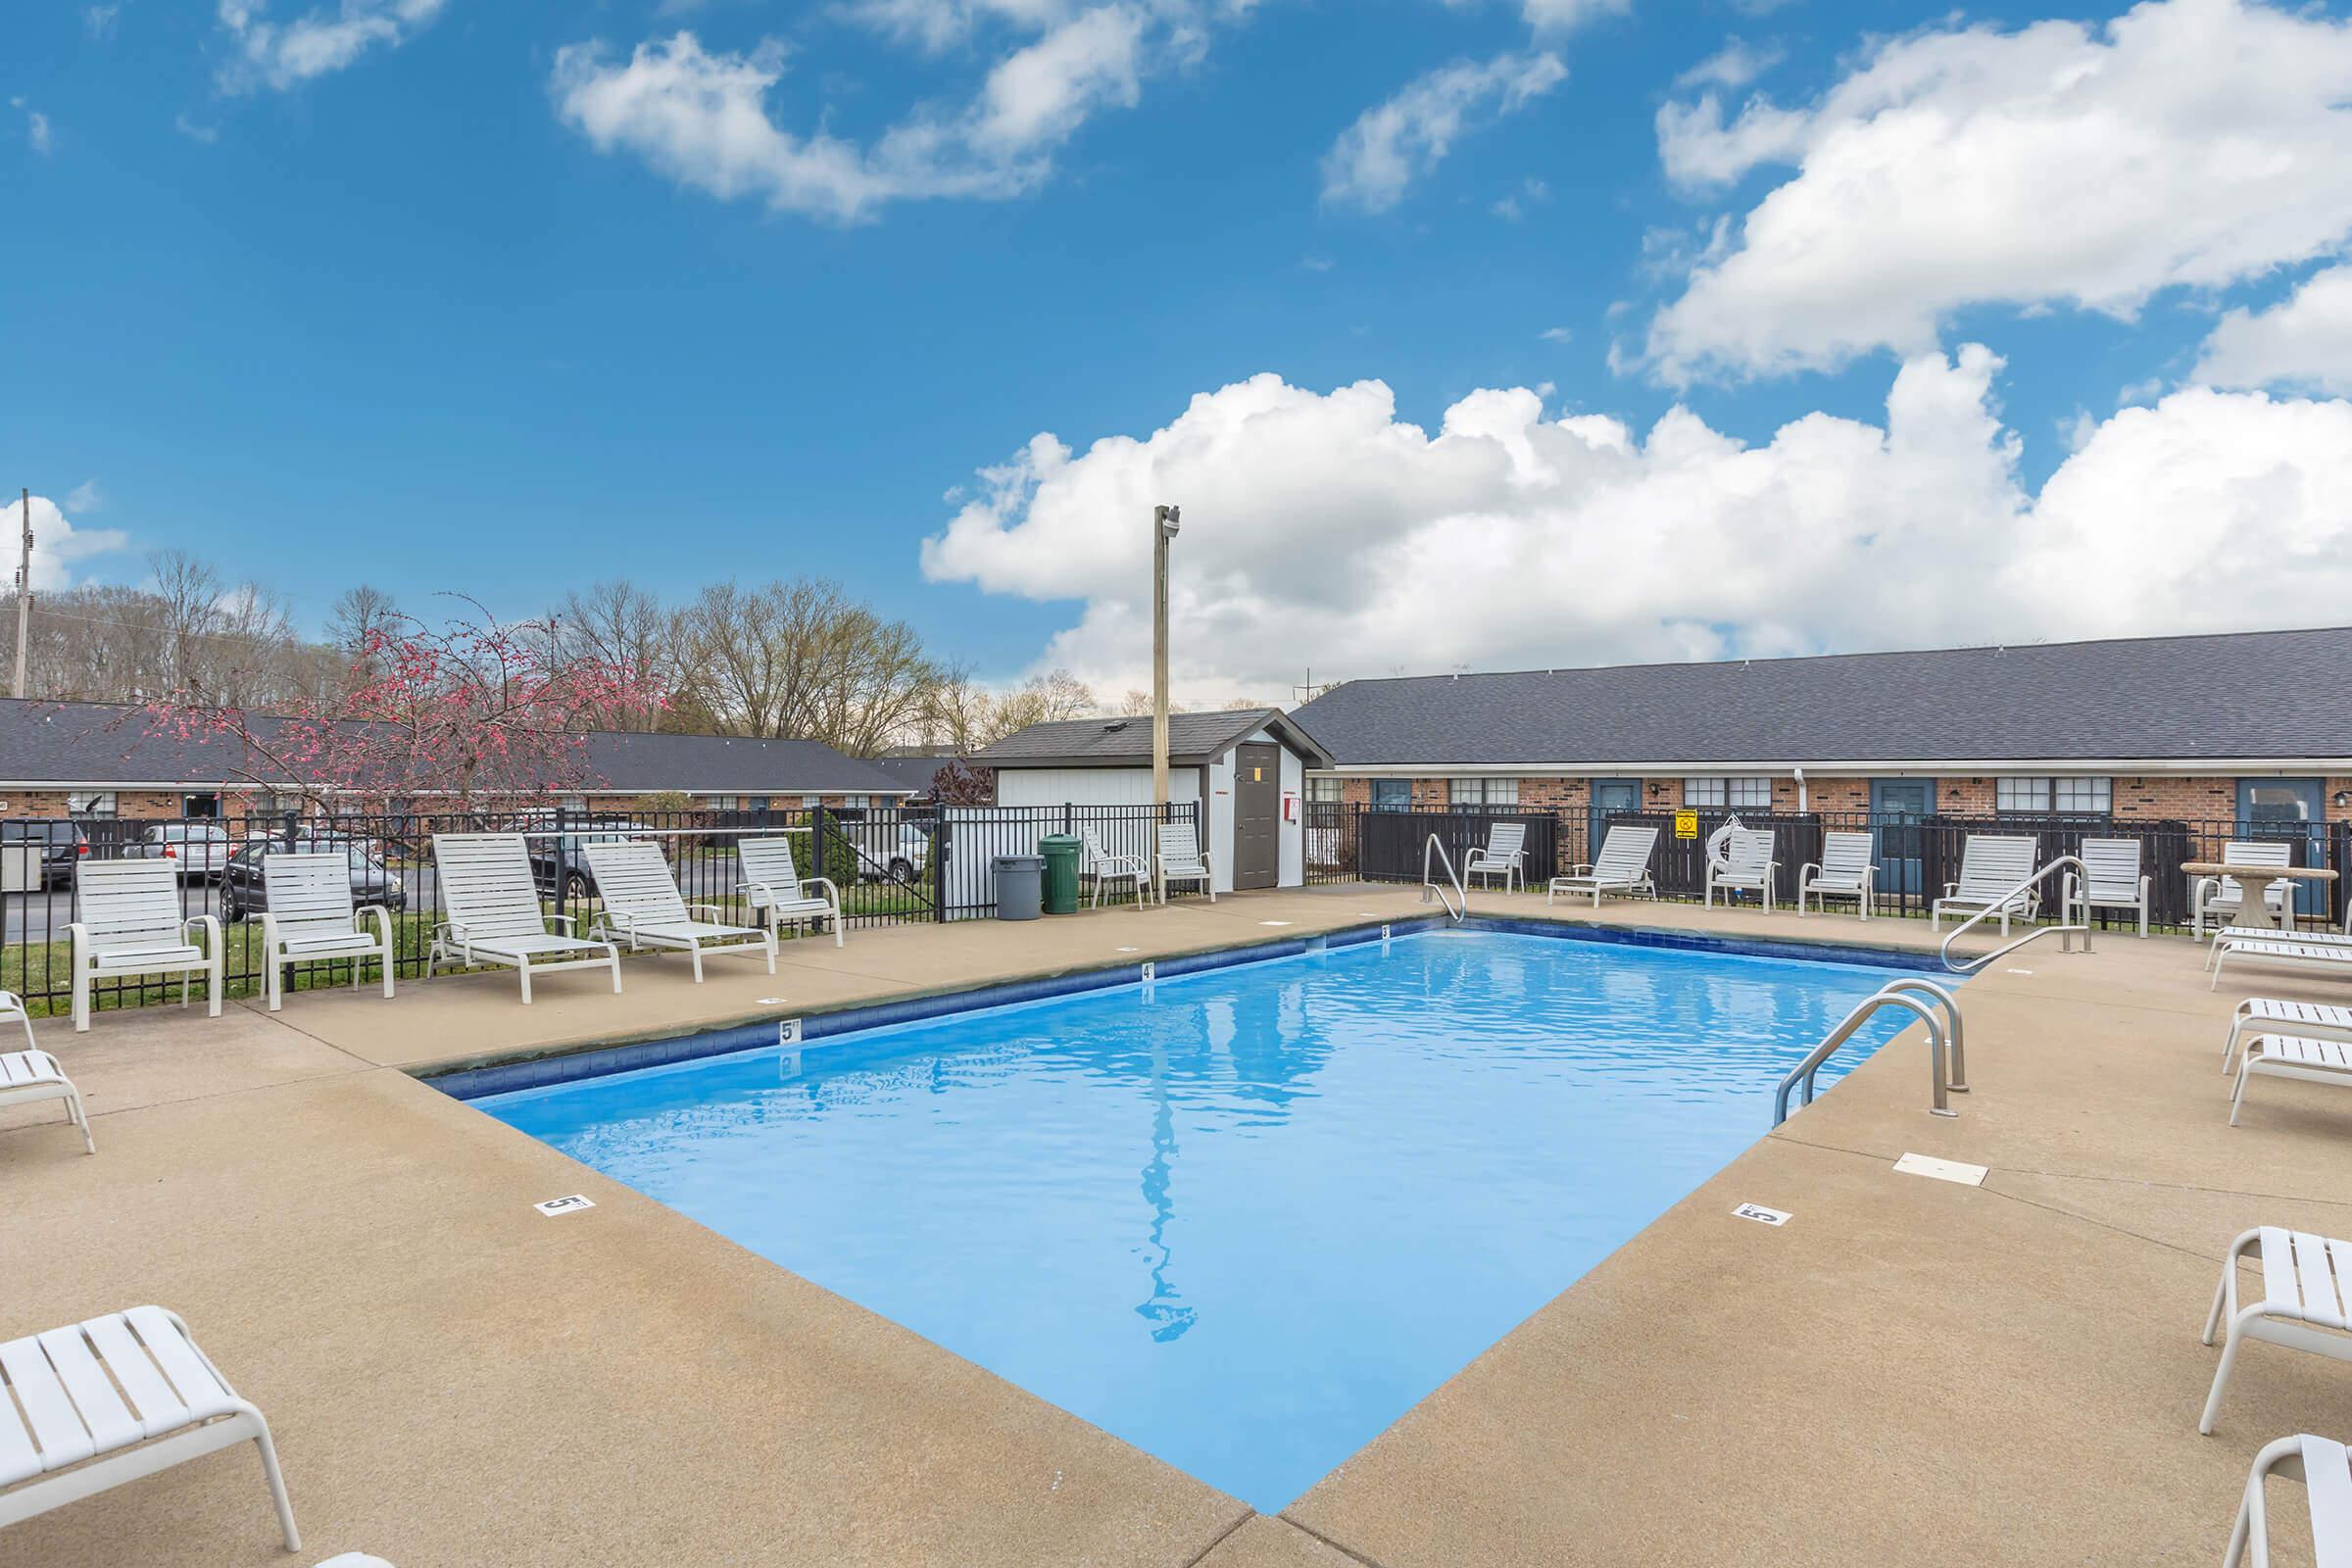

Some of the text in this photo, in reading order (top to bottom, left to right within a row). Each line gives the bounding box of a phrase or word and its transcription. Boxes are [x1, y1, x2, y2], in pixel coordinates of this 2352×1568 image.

[1144, 964, 1150, 978] 4
[782, 1022, 793, 1041] 5
[544, 1197, 580, 1208] 5
[1740, 1209, 1778, 1222] 5
